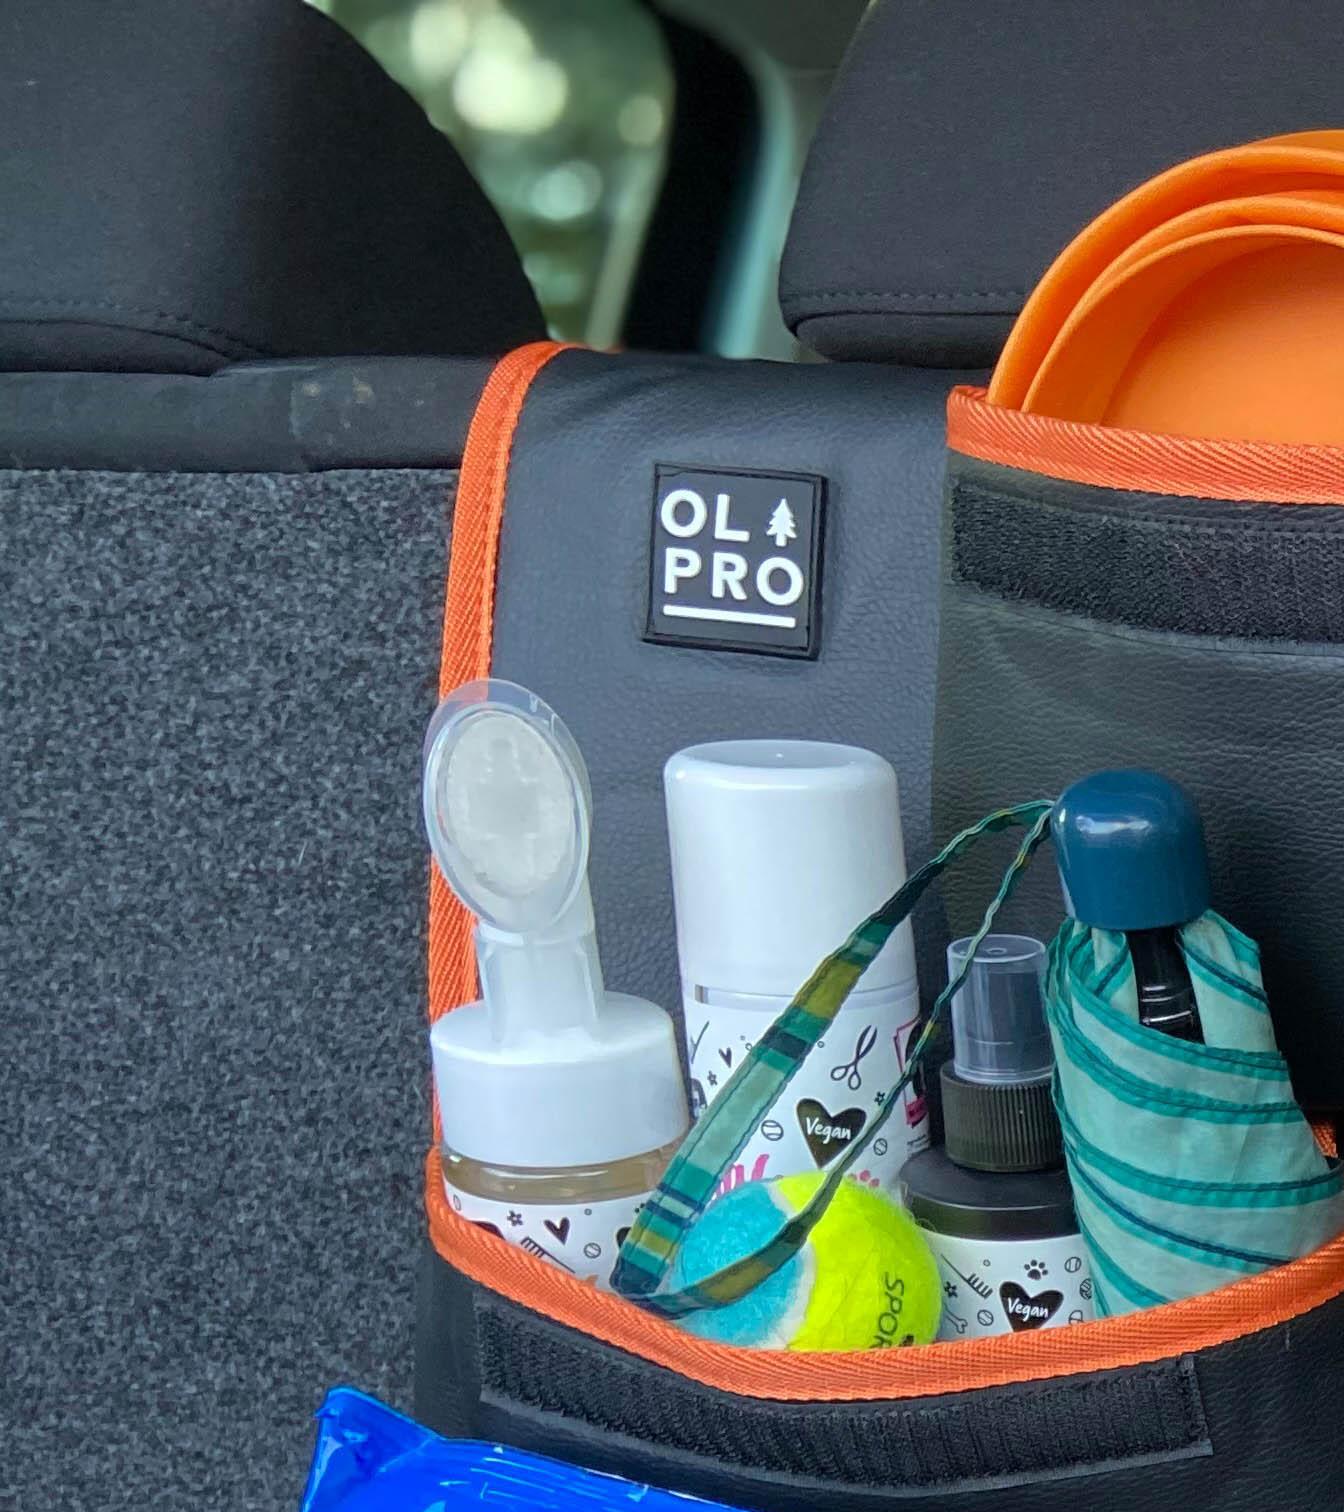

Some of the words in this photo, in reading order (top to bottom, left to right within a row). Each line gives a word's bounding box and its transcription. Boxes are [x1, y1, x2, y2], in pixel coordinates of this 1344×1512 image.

[660, 489, 750, 542] OL
[663, 547, 804, 606] PRO
[805, 1117, 851, 1144] Vegan
[1007, 1297, 1049, 1322] Vegan
